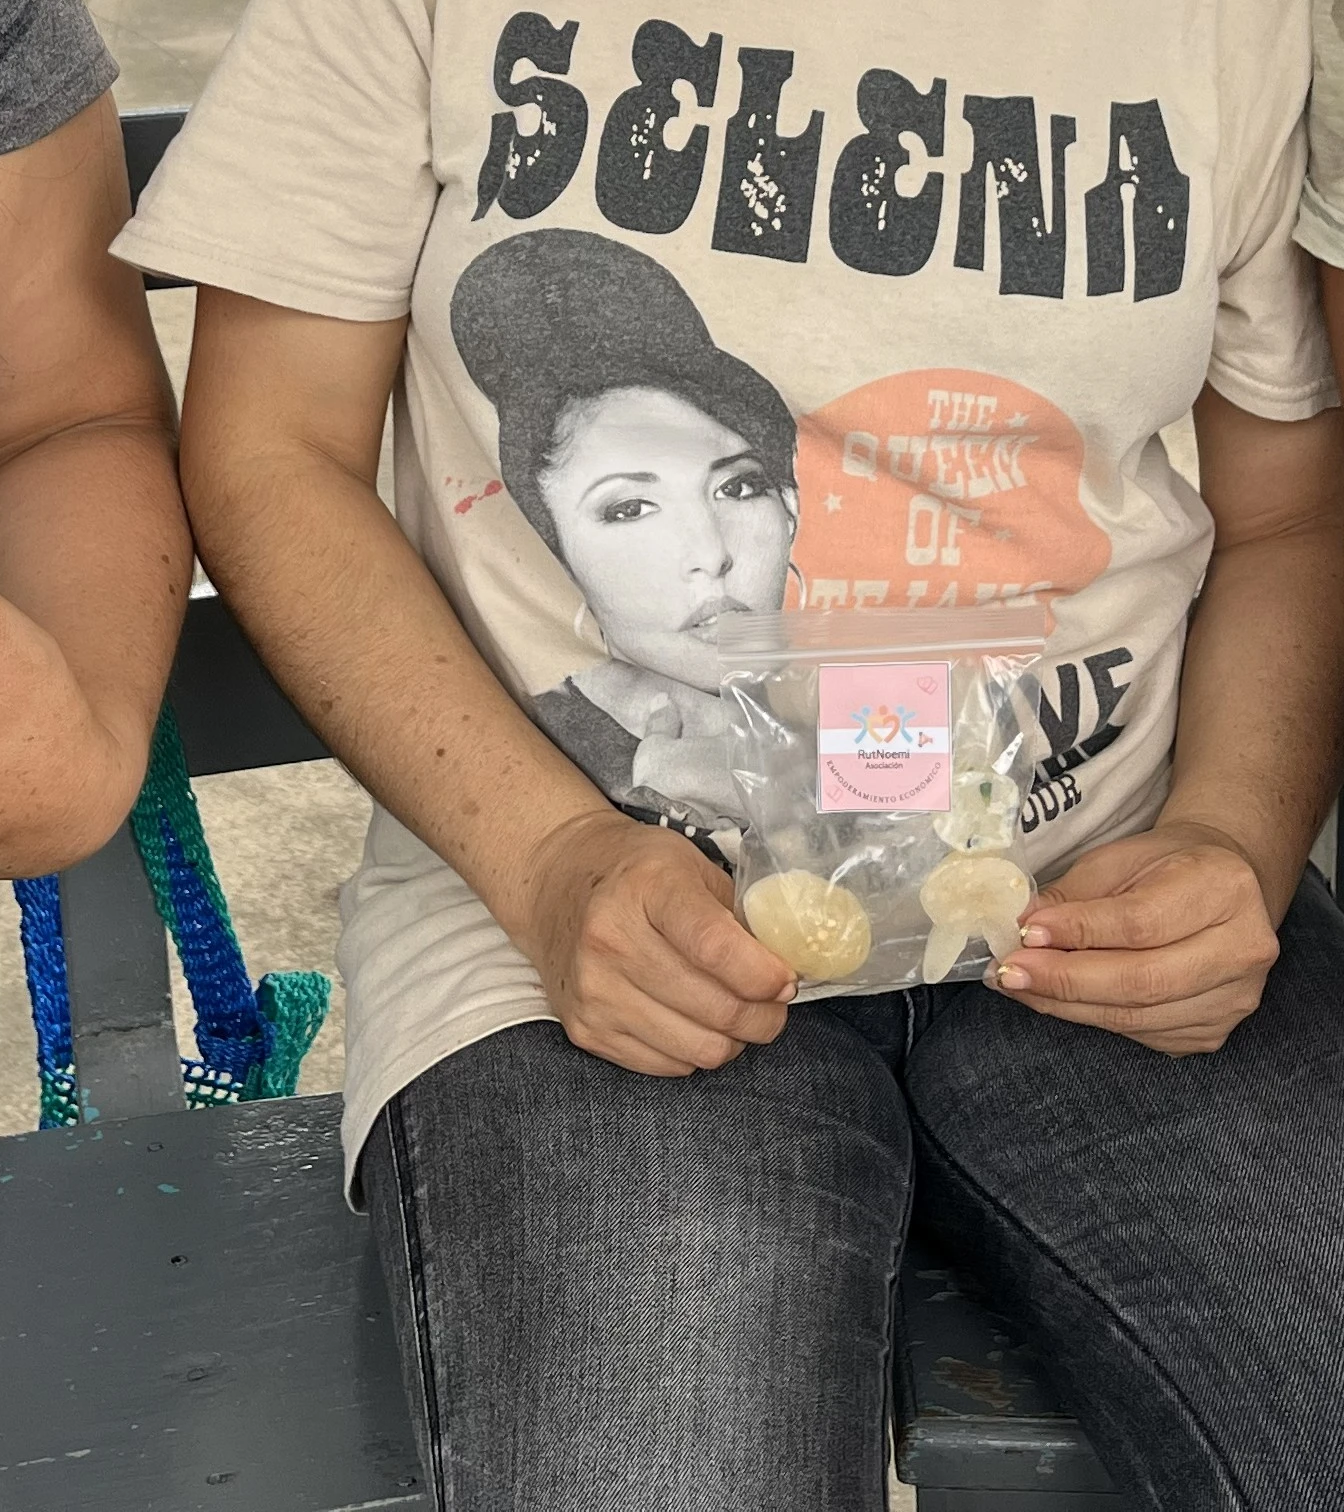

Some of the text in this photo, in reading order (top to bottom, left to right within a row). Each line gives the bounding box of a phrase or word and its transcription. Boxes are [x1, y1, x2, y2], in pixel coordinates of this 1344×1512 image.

[470, 11, 1190, 303] SELENA
[927, 388, 998, 432] THE
[841, 430, 1040, 500] QUEEN
[905, 493, 983, 566] OF
[827, 760, 896, 803] EMPODERAMIENTO
[858, 749, 910, 759] RutNoemi
